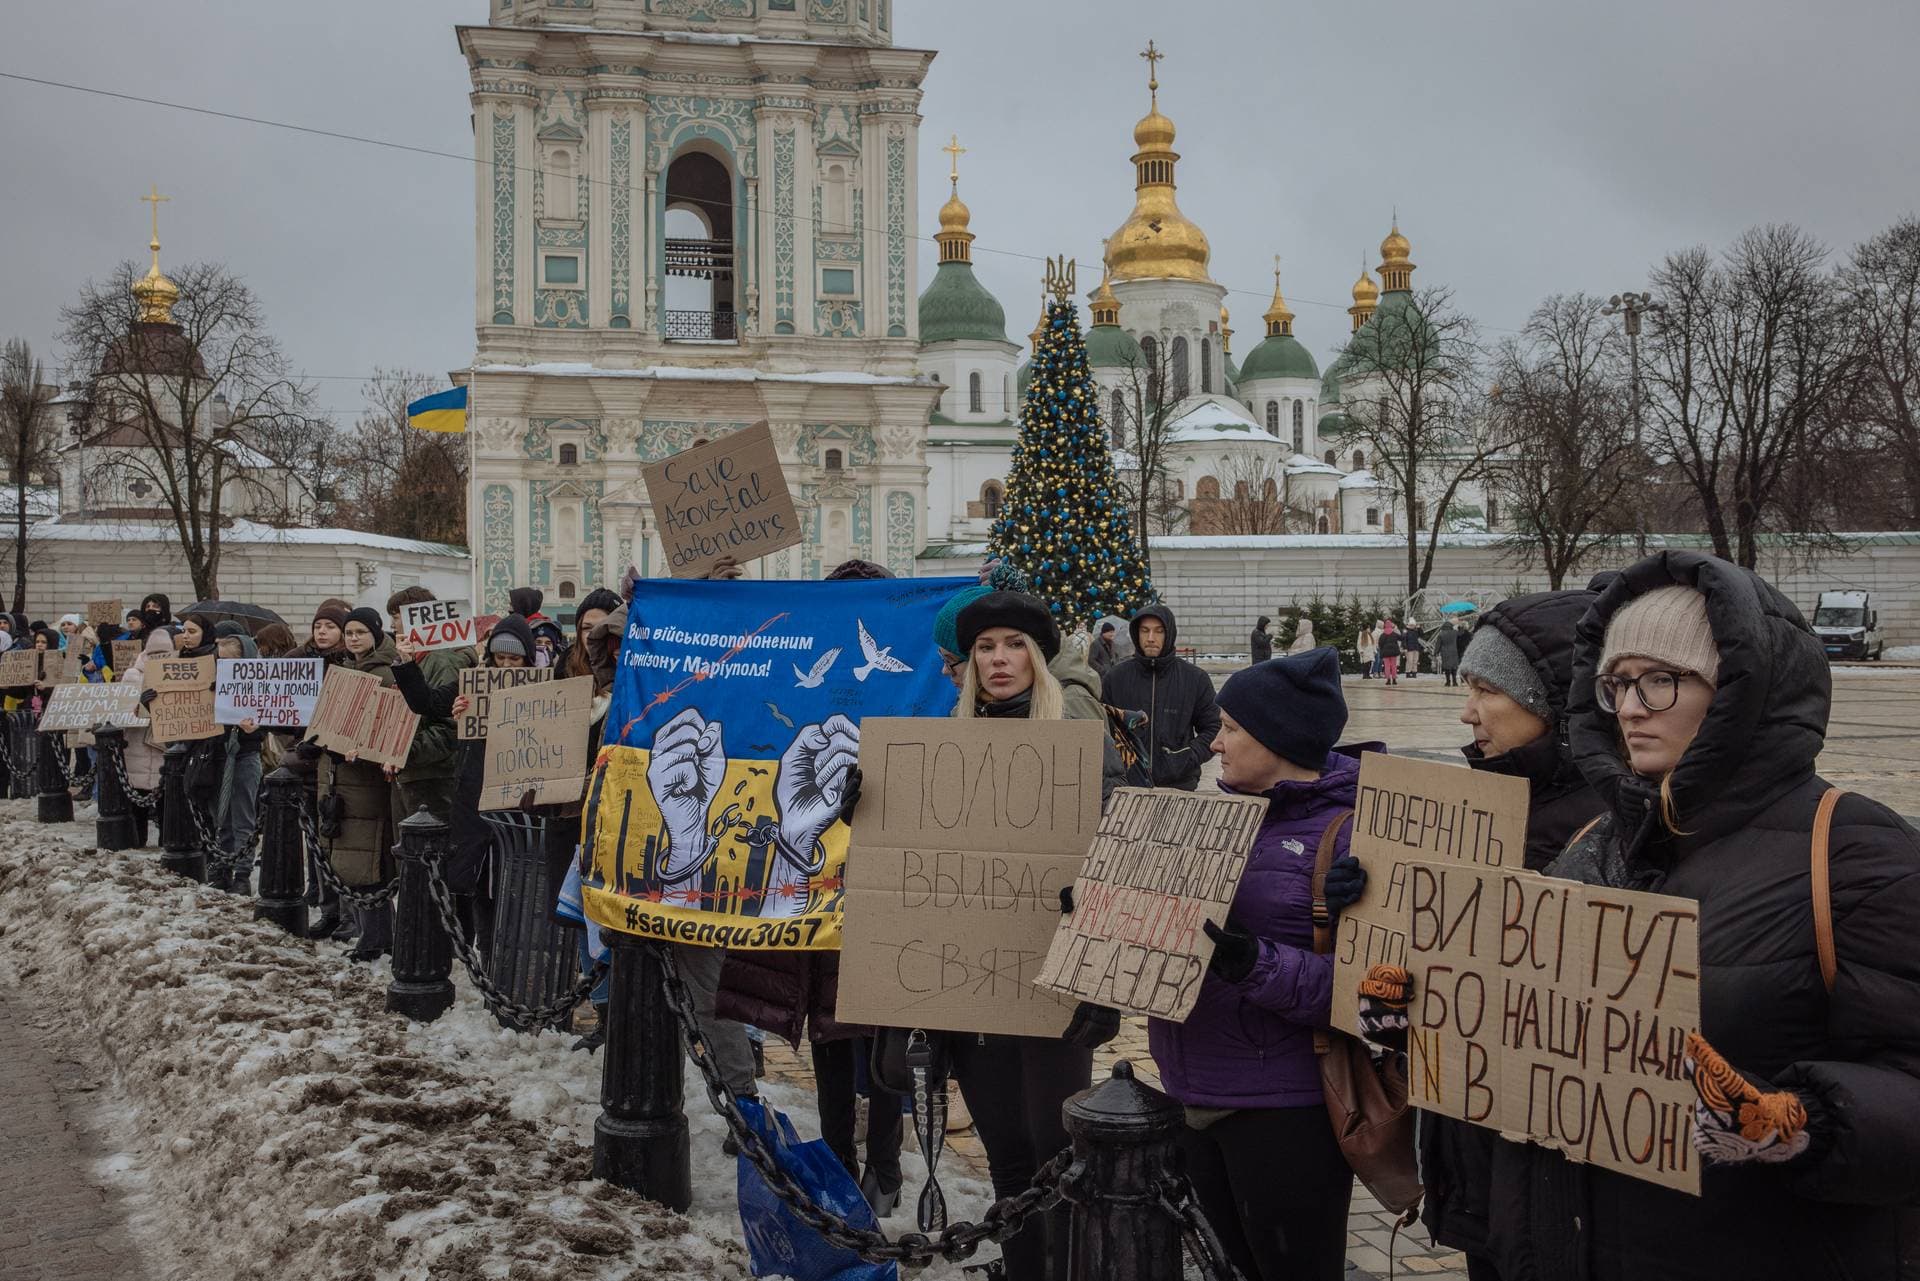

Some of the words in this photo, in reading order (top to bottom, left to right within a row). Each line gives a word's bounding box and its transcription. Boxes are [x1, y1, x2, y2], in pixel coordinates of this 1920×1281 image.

[665, 456, 743, 508] Save
[672, 514, 785, 567] defenders
[408, 602, 459, 625] FREE
[409, 620, 471, 646] AZOV
[653, 625, 814, 650] військовополоненим
[162, 662, 199, 672] FREE
[163, 672, 199, 680] AZOV
[683, 656, 772, 679] Маріуполя!
[219, 681, 253, 695] ДРУГИЙ
[275, 683, 280, 696] У
[233, 695, 295, 707] ПОВЕРНІТЬ
[166, 703, 213, 720] ВІДЧУВА
[257, 709, 301, 725] 74-ОРБ
[882, 742, 1082, 834] ПОЛОН
[903, 850, 1062, 913] ВБИВАЄ
[1411, 866, 1483, 957] ВИ
[897, 940, 1060, 1006] СВЯТ
[1052, 934, 1105, 995] ДЕ
[1094, 943, 1202, 1016] АЗОВ?
[1421, 966, 1485, 1038] БО
[1463, 1040, 1494, 1122] В
[913, 1067, 928, 1137] JACOBS
